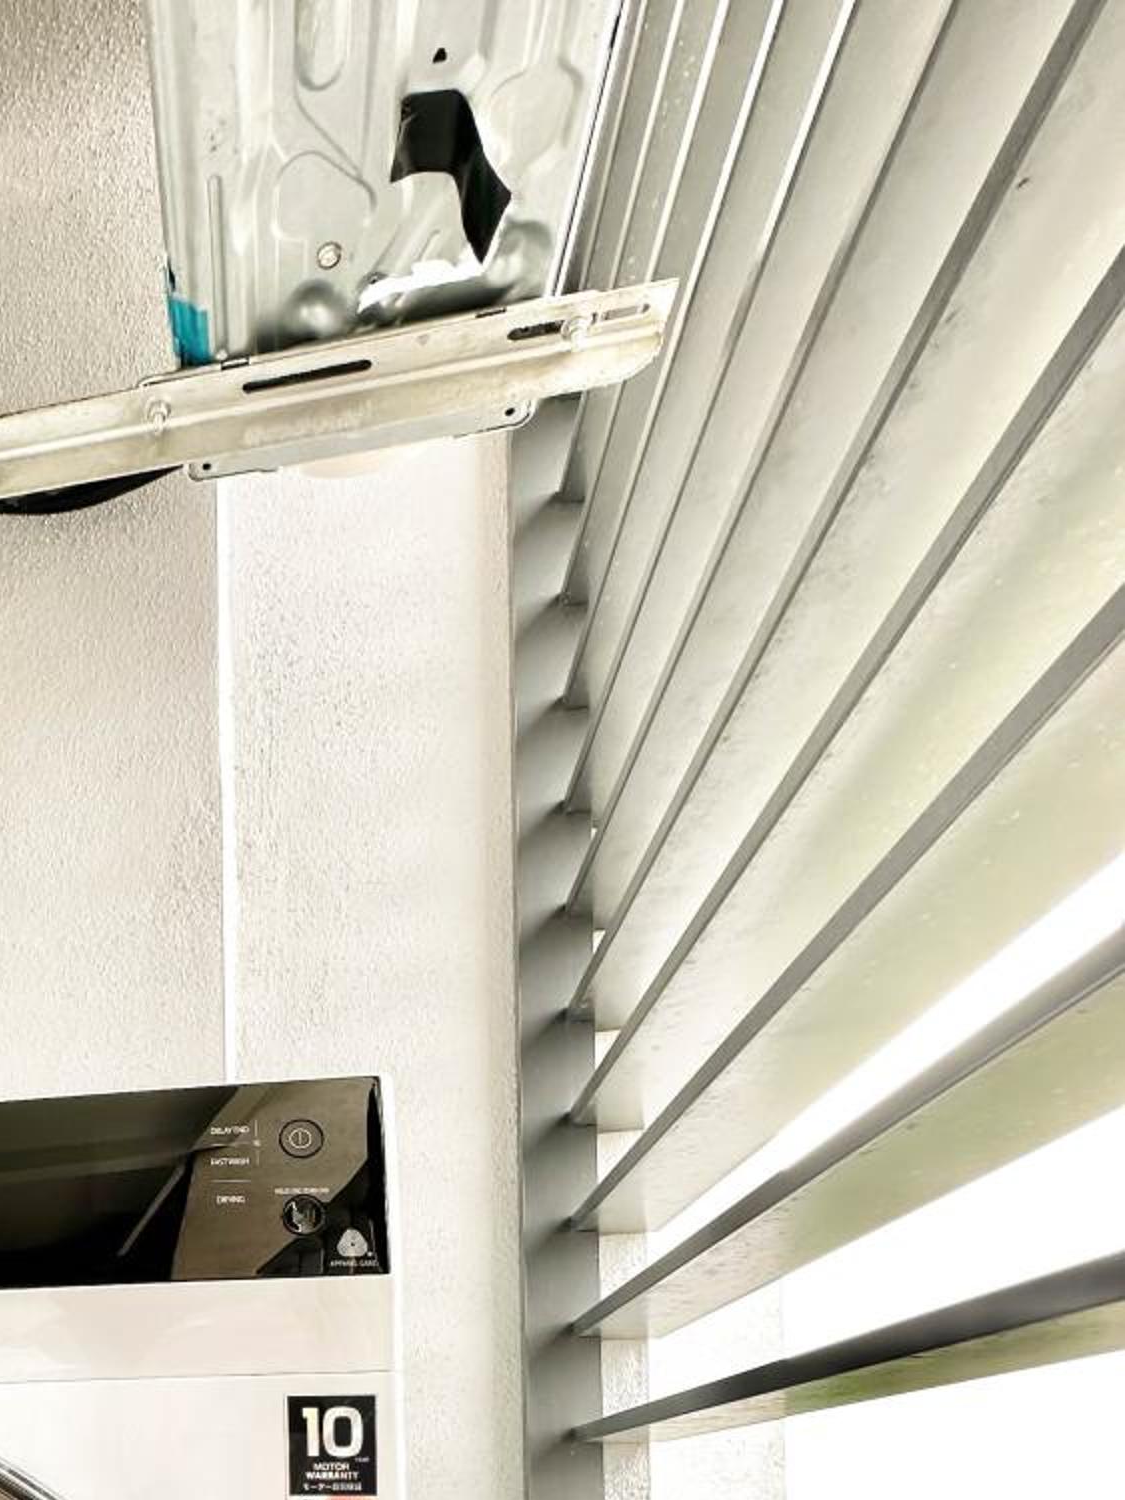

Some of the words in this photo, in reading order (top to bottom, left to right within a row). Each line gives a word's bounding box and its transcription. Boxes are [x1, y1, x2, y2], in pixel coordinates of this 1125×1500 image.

[301, 1406, 364, 1458] 10
[313, 1462, 350, 1471] MOTOR
[305, 1471, 359, 1480] WARRANTY
